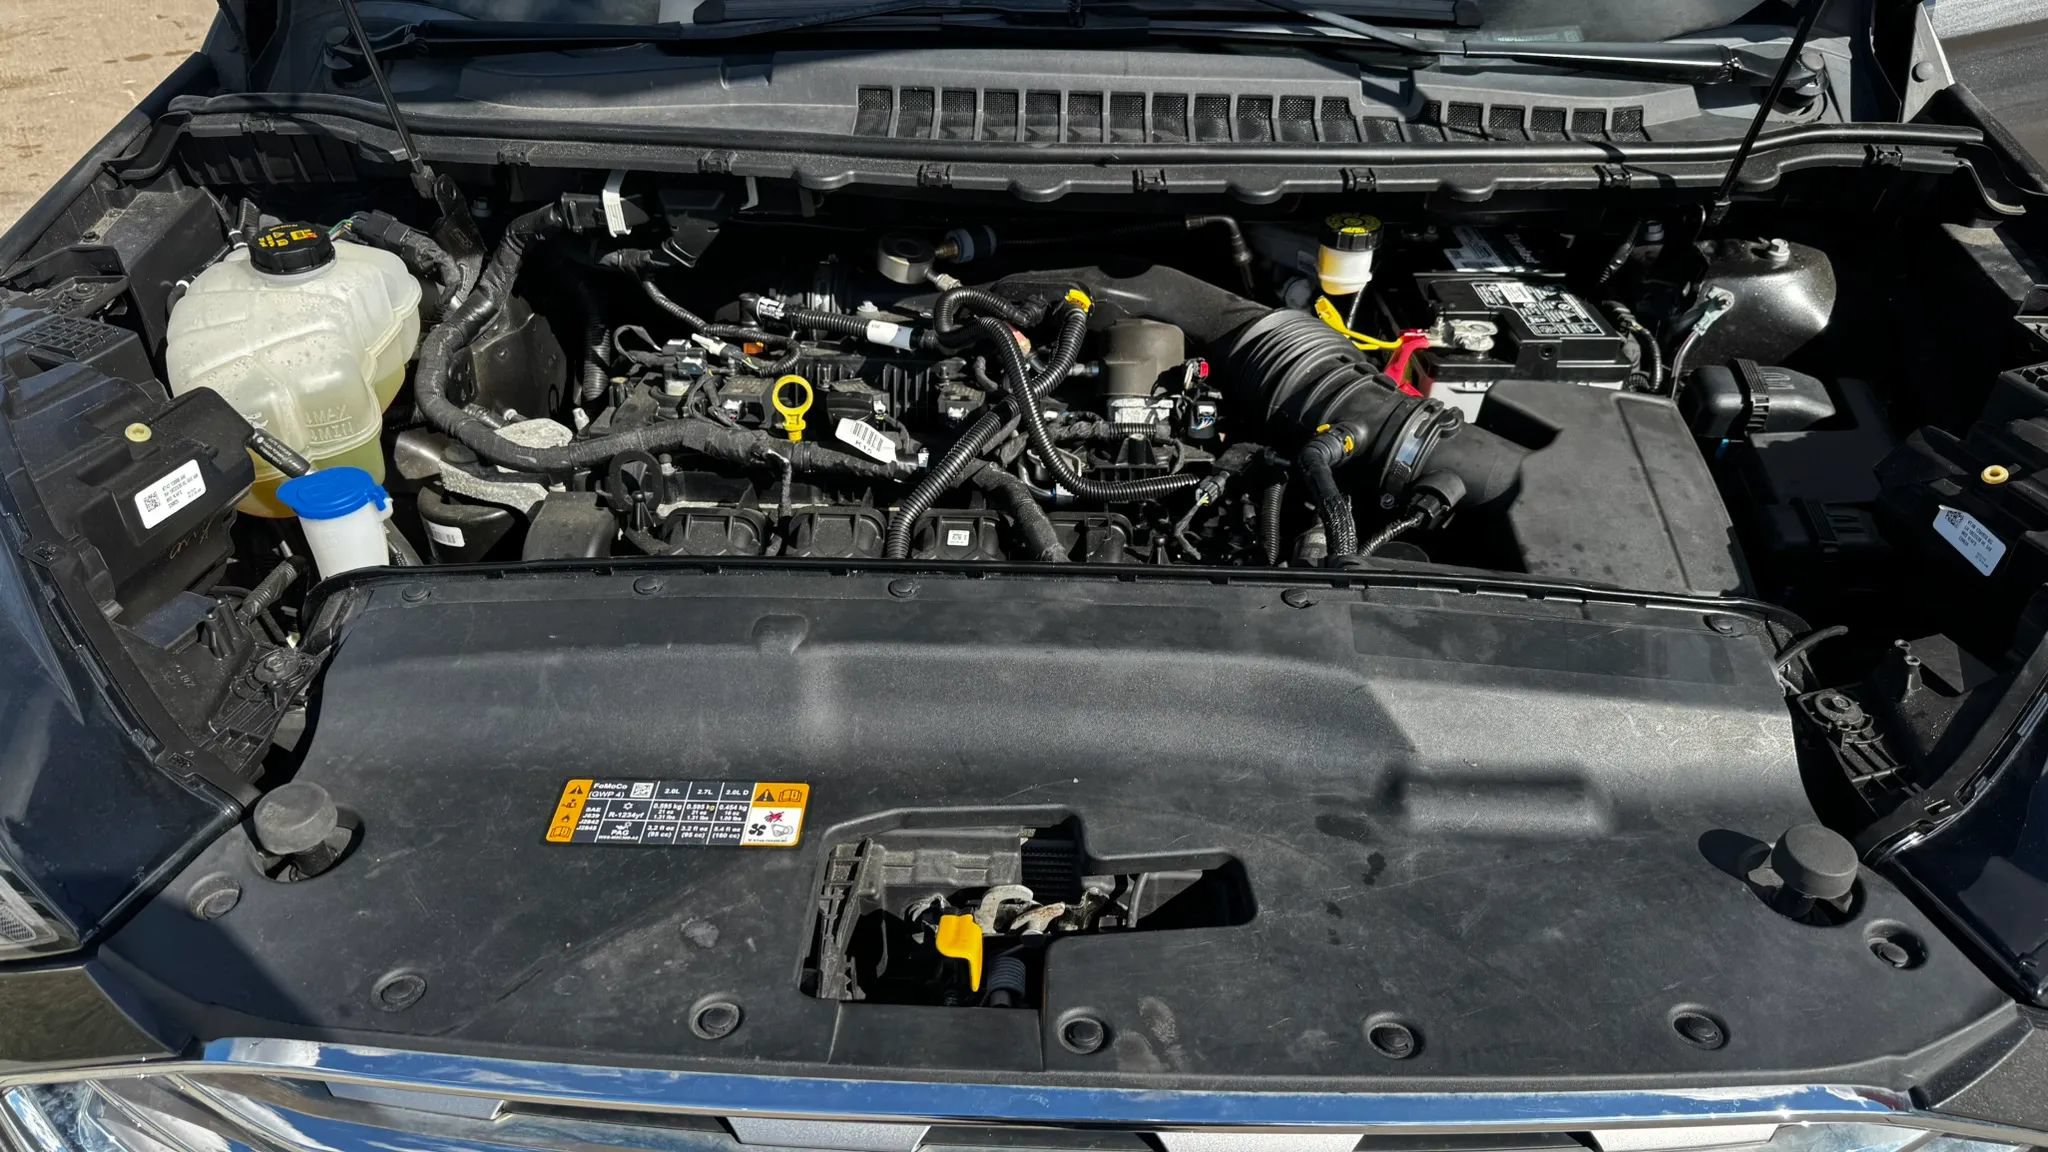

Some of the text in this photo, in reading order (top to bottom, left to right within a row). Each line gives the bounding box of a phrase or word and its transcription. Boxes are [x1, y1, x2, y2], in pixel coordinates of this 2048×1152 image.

[312, 404, 347, 425] MAX
[593, 782, 628, 790] FoMoCo
[673, 803, 682, 811] kg
[706, 804, 716, 812] kg
[738, 804, 748, 812] kg
[607, 812, 645, 820] R-1234yf
